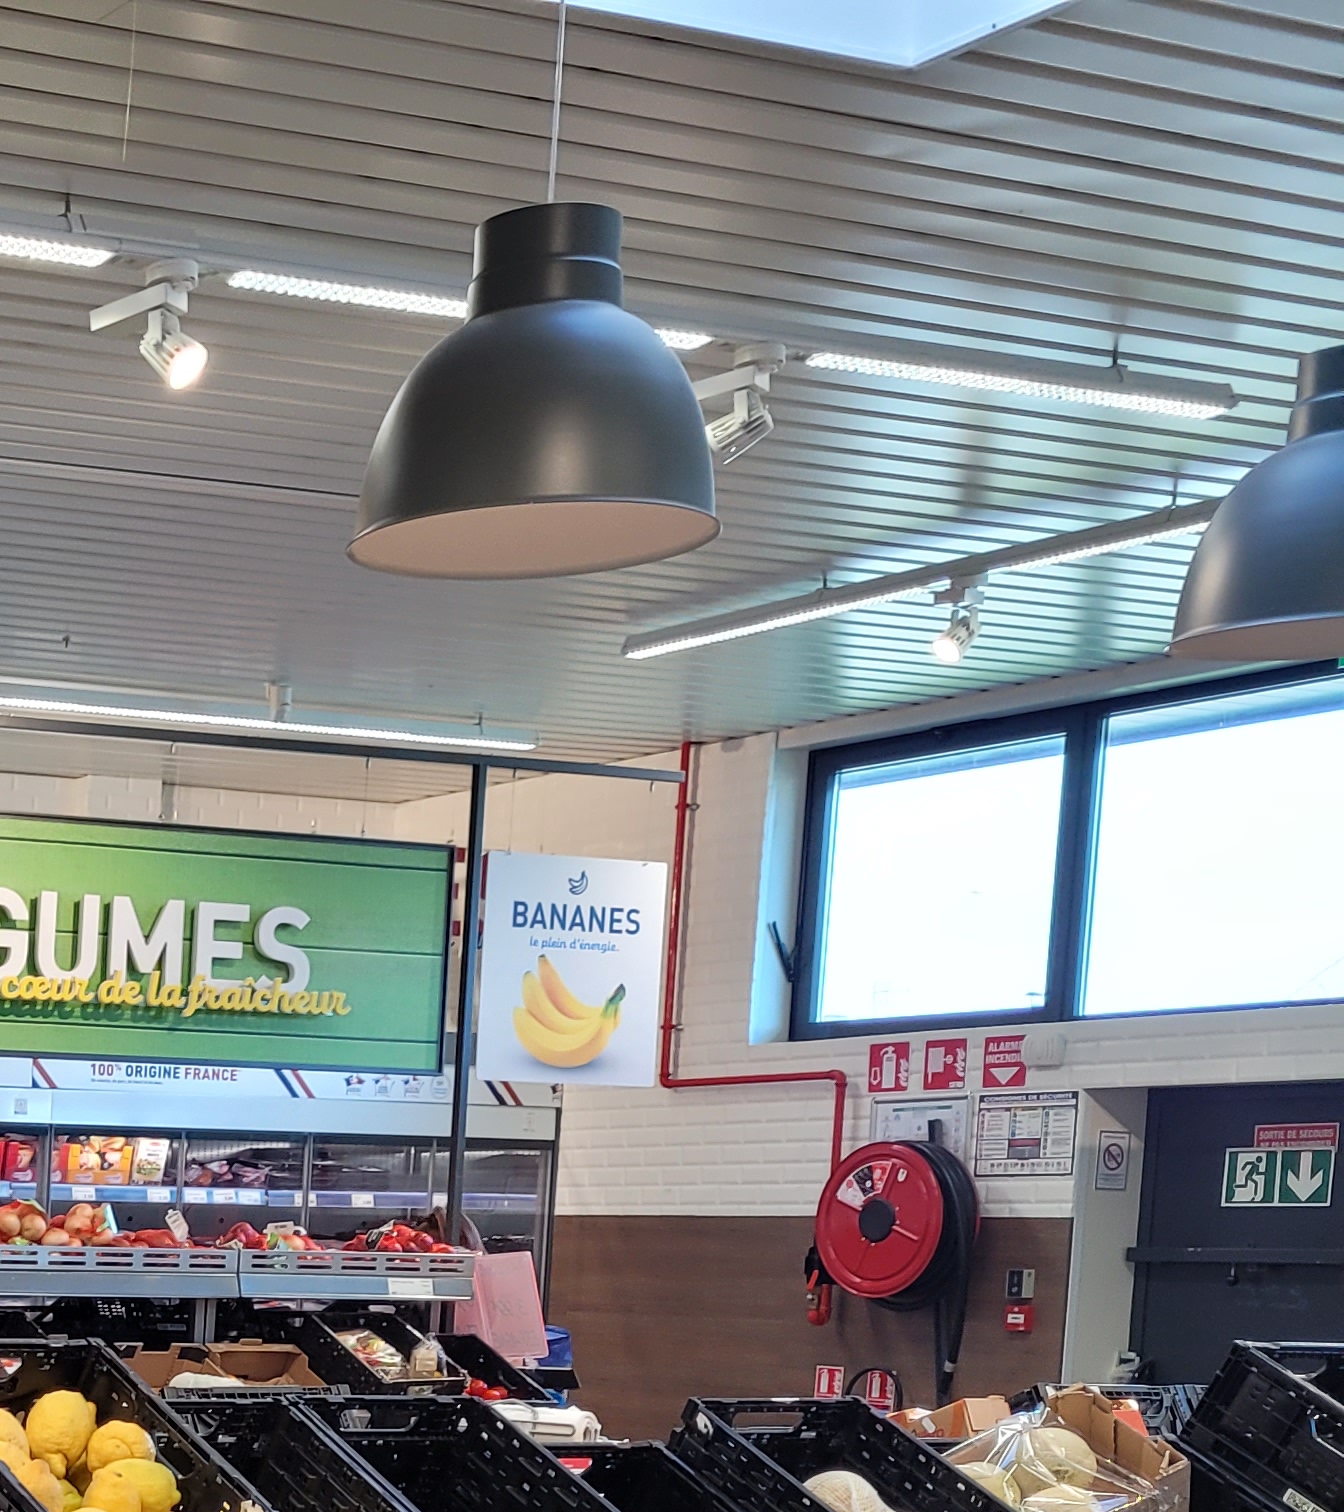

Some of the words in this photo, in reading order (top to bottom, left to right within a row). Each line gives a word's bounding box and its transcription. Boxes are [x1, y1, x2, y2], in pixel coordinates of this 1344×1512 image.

[511, 900, 641, 935] BANANES
[529, 936, 539, 948] le
[541, 937, 567, 951] plein
[0, 974, 95, 1005] cœur
[98, 968, 143, 1006] de
[146, 970, 184, 1007] la
[181, 976, 352, 1019] fraîcheur
[125, 1065, 181, 1079] ORIGINE
[184, 1067, 238, 1081] FRANCE
[1259, 1130, 1285, 1140] SORTIE
[1287, 1129, 1297, 1139] DE
